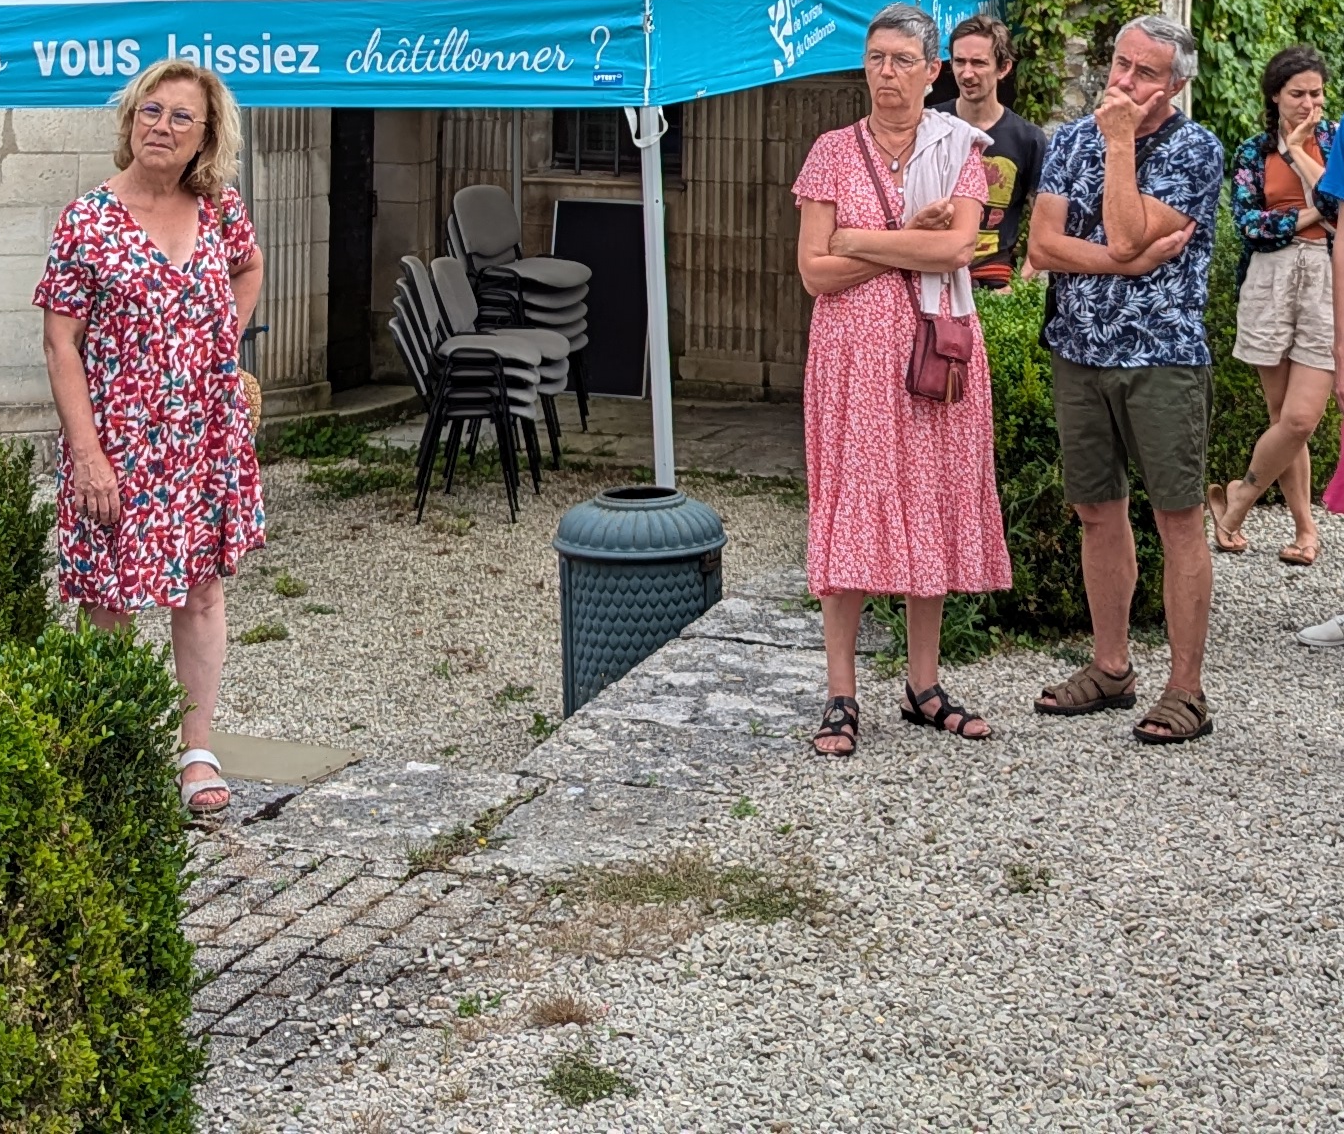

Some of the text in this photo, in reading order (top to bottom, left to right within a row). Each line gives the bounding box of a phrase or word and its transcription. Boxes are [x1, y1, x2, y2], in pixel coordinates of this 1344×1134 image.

[793, 2, 823, 33] de Tourisme
[33, 37, 142, 77] vous
[167, 32, 320, 74] laissiez
[345, 26, 575, 74] châtillonner
[589, 25, 612, 70] ?
[796, 40, 805, 58] du
